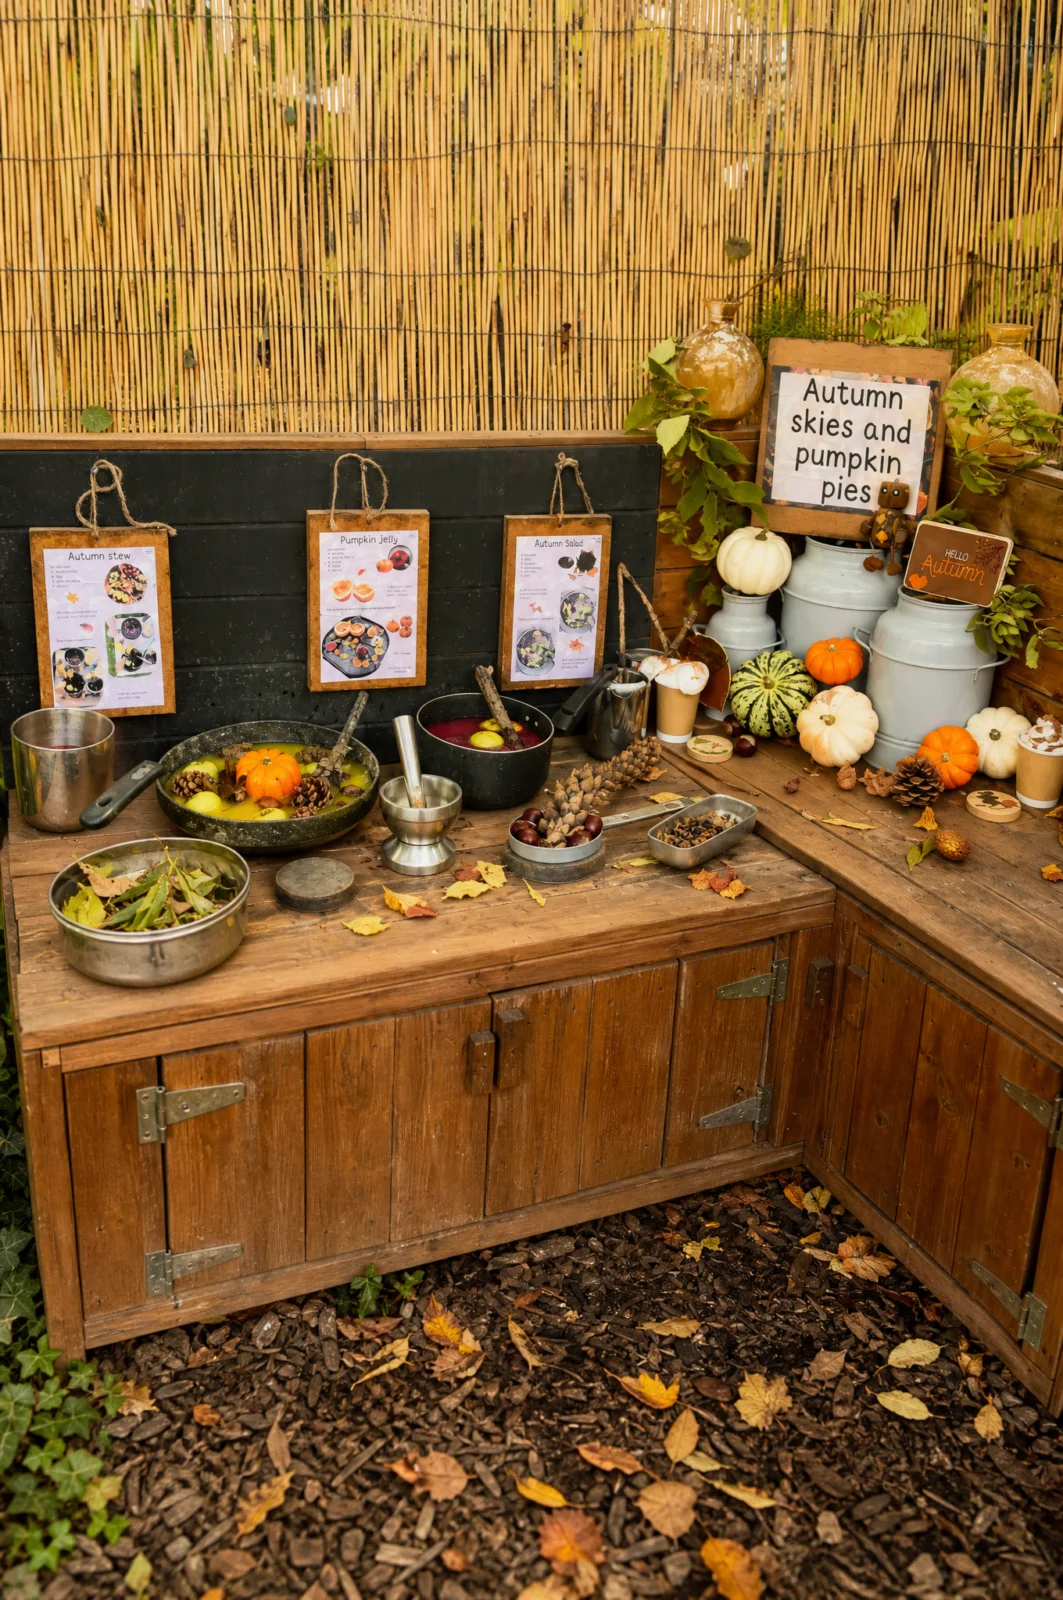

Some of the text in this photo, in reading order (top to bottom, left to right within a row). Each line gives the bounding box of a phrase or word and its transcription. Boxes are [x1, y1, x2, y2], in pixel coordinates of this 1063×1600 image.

[802, 377, 904, 411] Autumn
[790, 408, 912, 445] skies and
[794, 446, 902, 478] pumpkin
[820, 475, 872, 505] pies
[340, 535, 376, 546] Pumpkin
[379, 534, 399, 545] jelly
[534, 539, 563, 548] Autumn
[565, 539, 584, 548] Salad
[944, 548, 969, 562] HELLO
[68, 551, 131, 561] Autumn stew
[920, 554, 985, 586] Autumn
